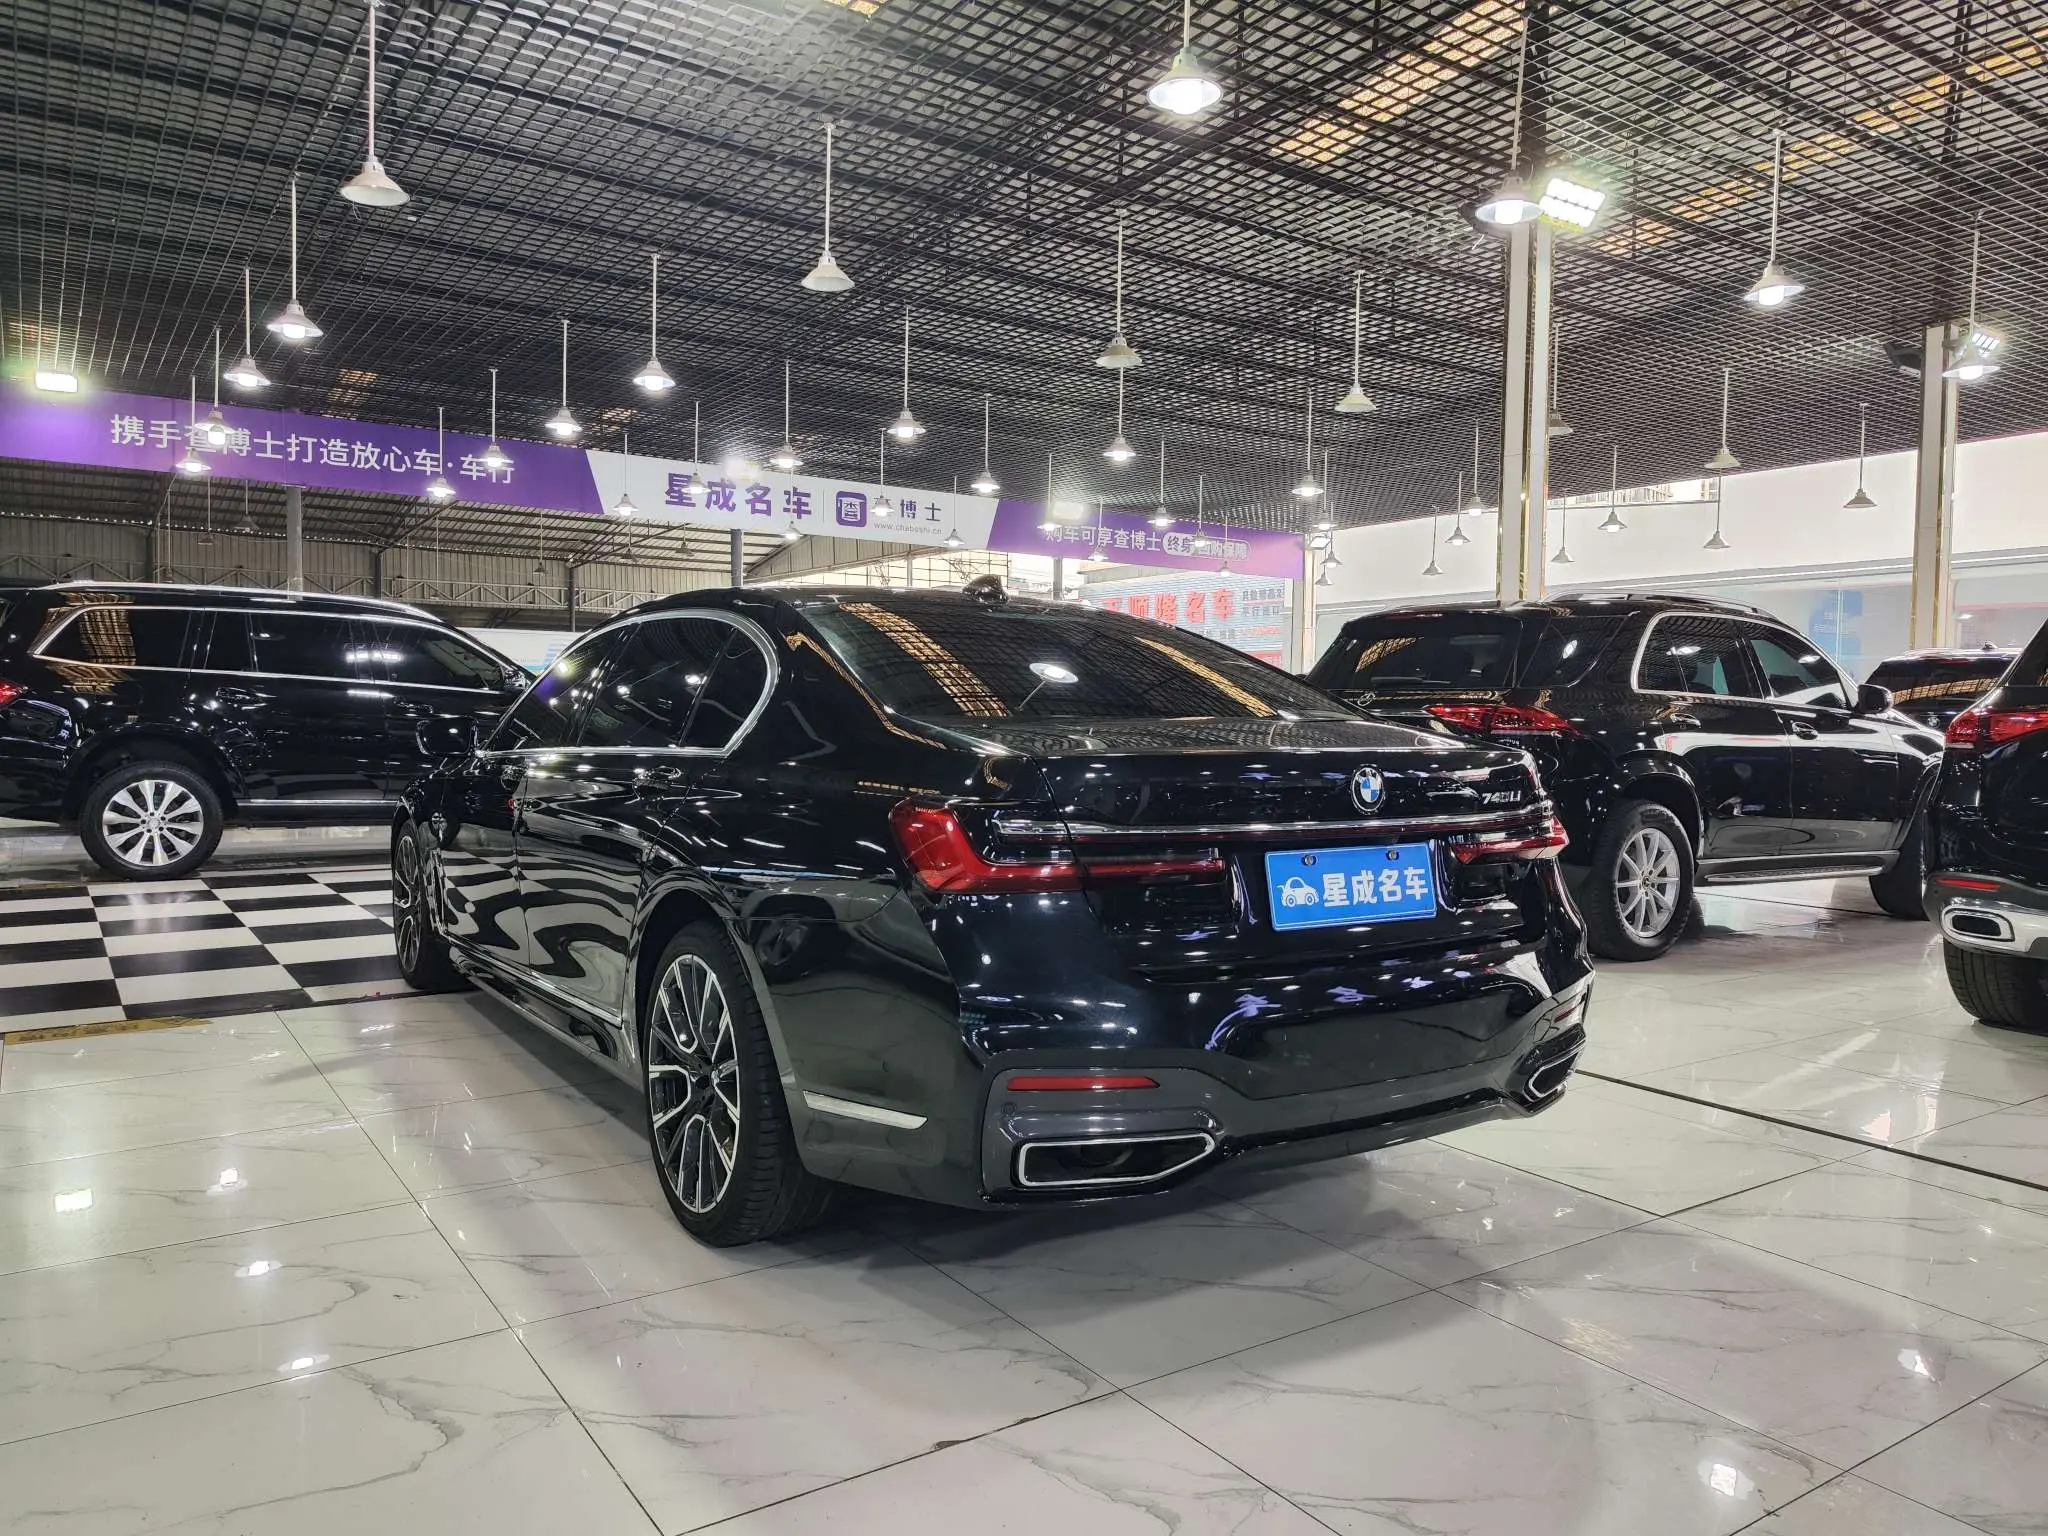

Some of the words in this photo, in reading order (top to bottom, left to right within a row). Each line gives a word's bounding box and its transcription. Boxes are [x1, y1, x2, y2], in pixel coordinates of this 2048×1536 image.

[664, 472, 812, 520] 星成名车
[1322, 866, 1428, 907] 星成名车
